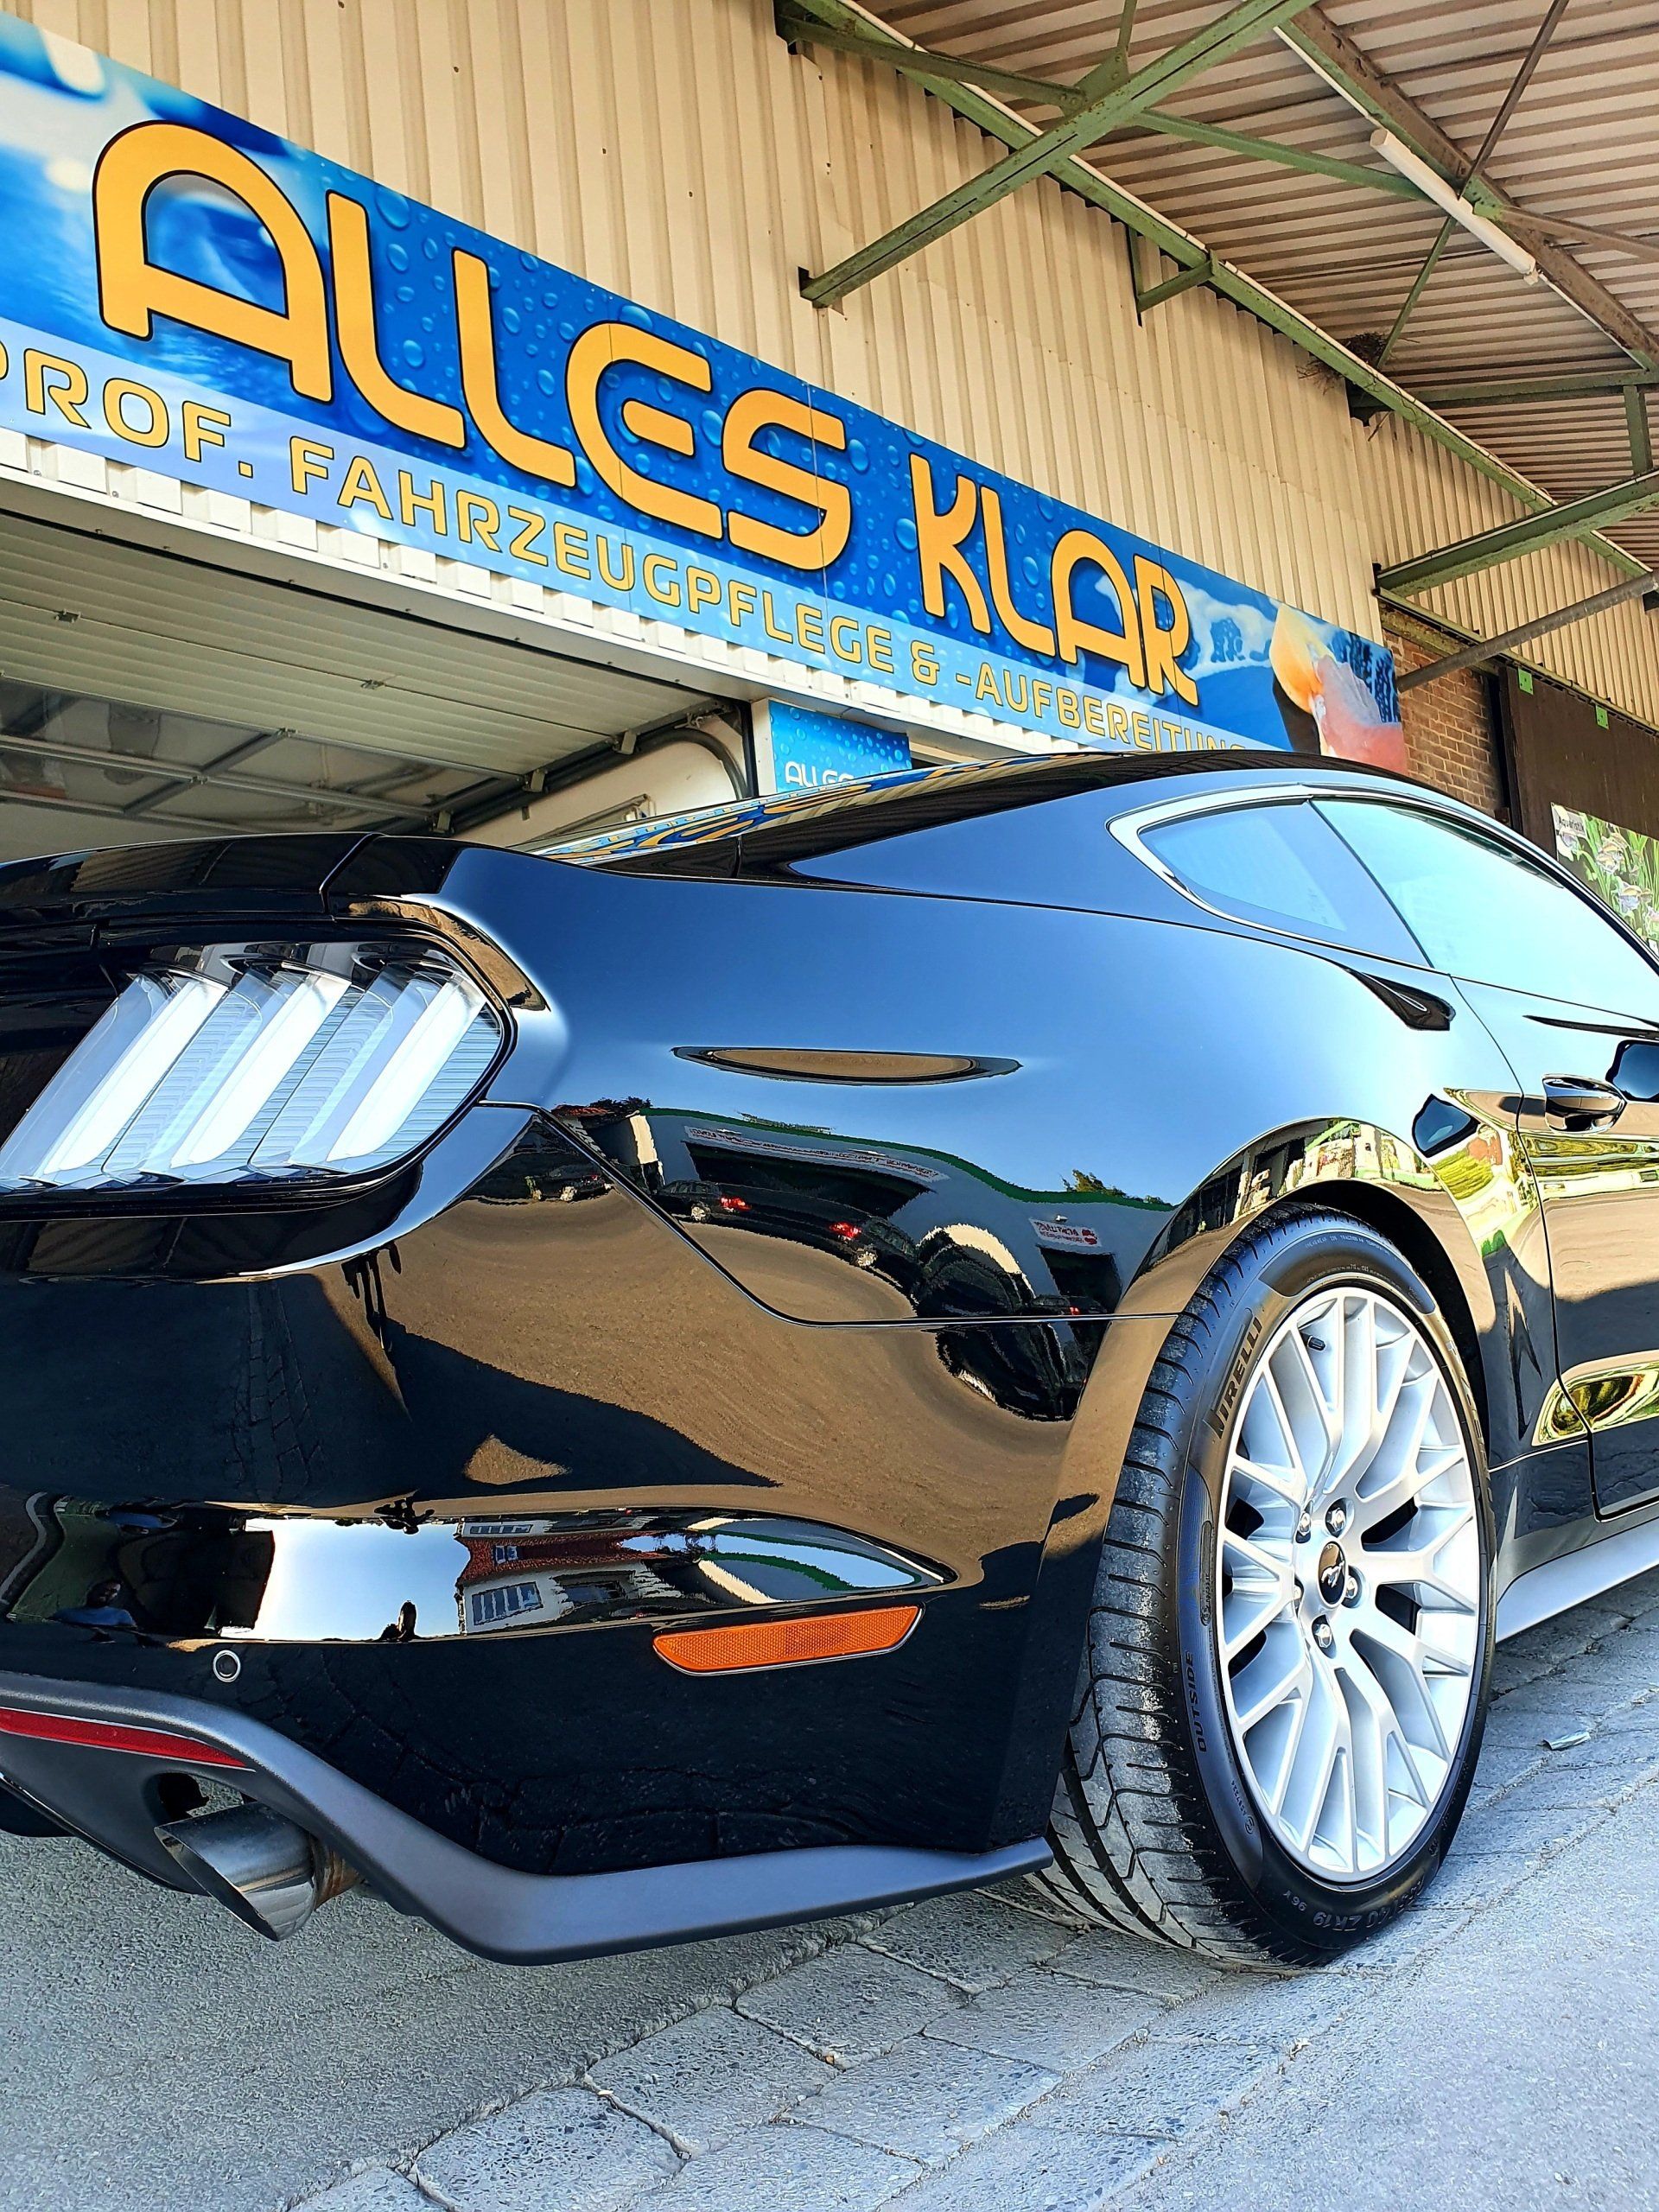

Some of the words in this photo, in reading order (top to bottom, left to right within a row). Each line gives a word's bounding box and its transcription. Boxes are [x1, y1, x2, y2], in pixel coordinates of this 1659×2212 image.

[0, 340, 253, 478] ROF.
[289, 435, 893, 673] FAHRZEUGPFLEGE
[911, 640, 940, 686] &
[955, 663, 1245, 752] -AUFBEREITU
[92, 119, 852, 570] ALLES
[910, 453, 1198, 706] KLAR
[1203, 1316, 1263, 1440] PIRELLI
[1185, 1650, 1207, 1753] OUTSIDE
